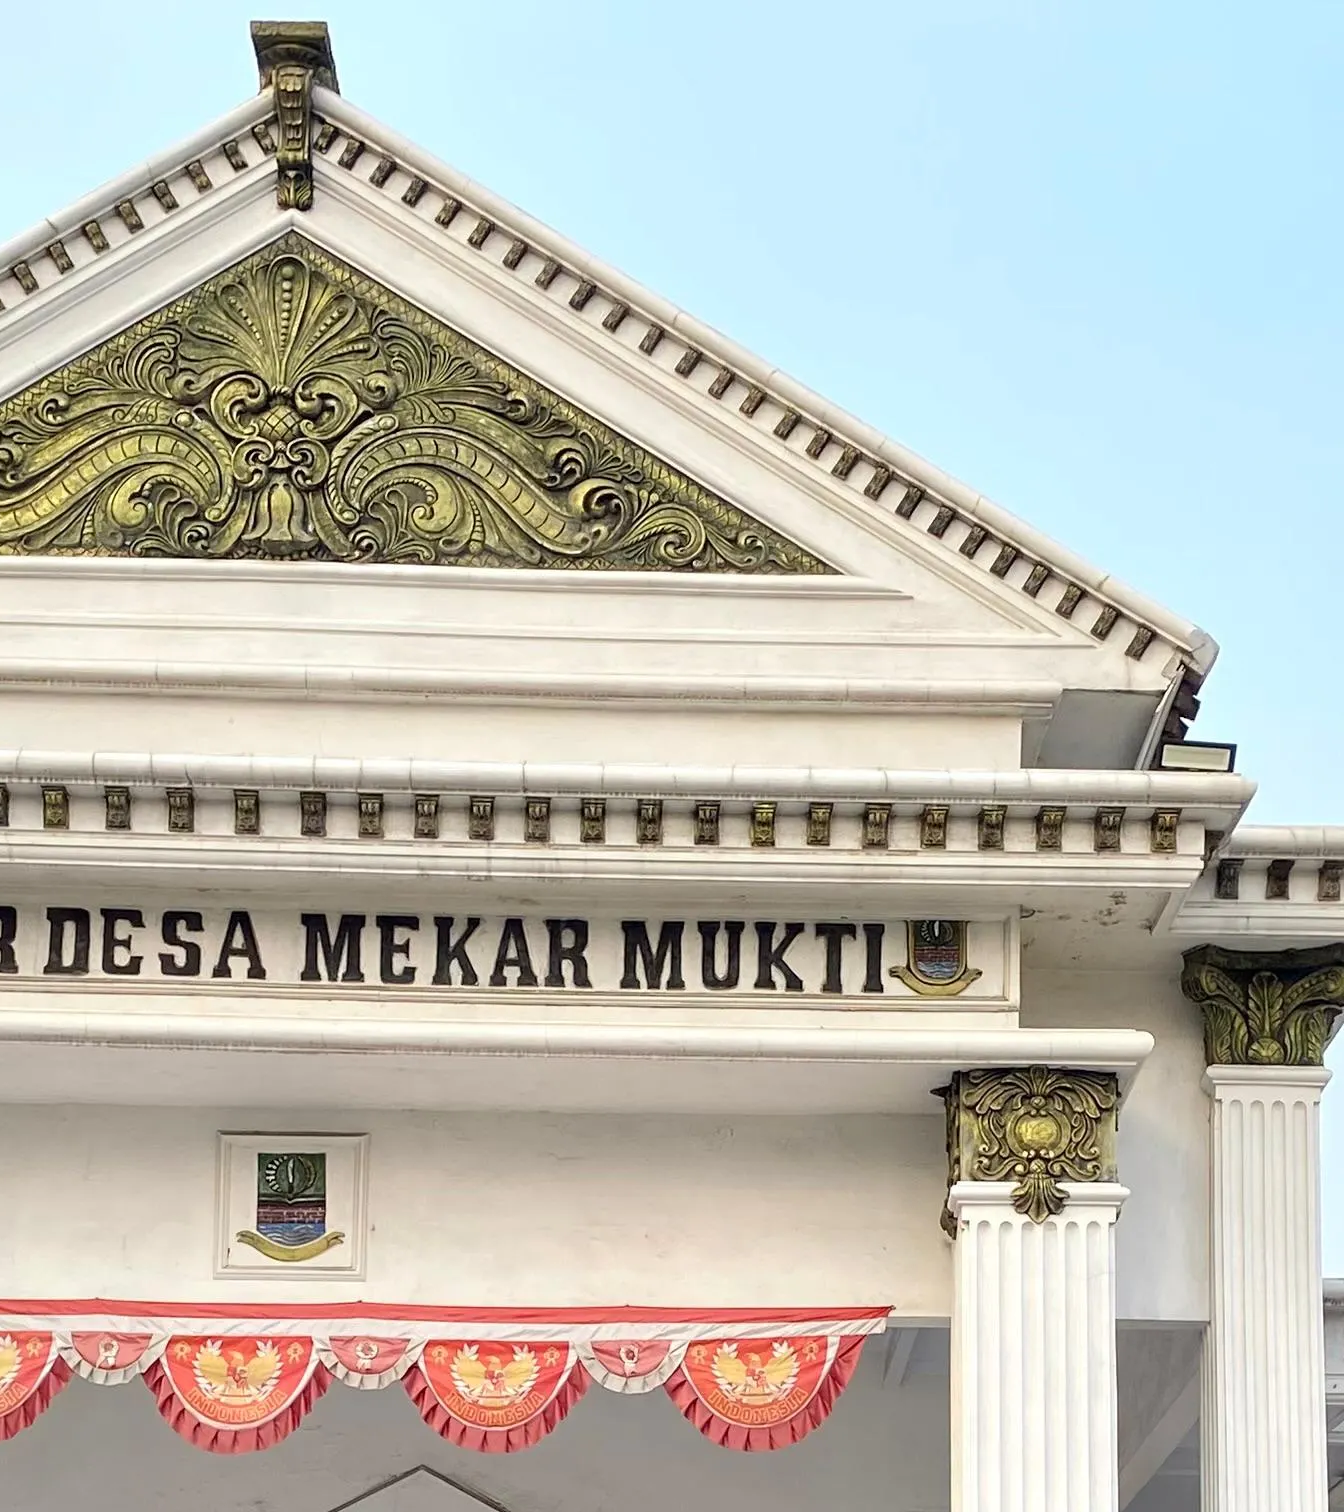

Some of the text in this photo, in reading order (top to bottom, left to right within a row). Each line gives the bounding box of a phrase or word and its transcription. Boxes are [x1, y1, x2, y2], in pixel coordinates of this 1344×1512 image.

[43, 906, 266, 980] DESA
[300, 912, 594, 989] MEKAR
[620, 920, 886, 994] MUKTI
[186, 1386, 288, 1421] INDONESIA
[444, 1391, 545, 1425] INDONESIA
[708, 1387, 808, 1422] INDONESIA
